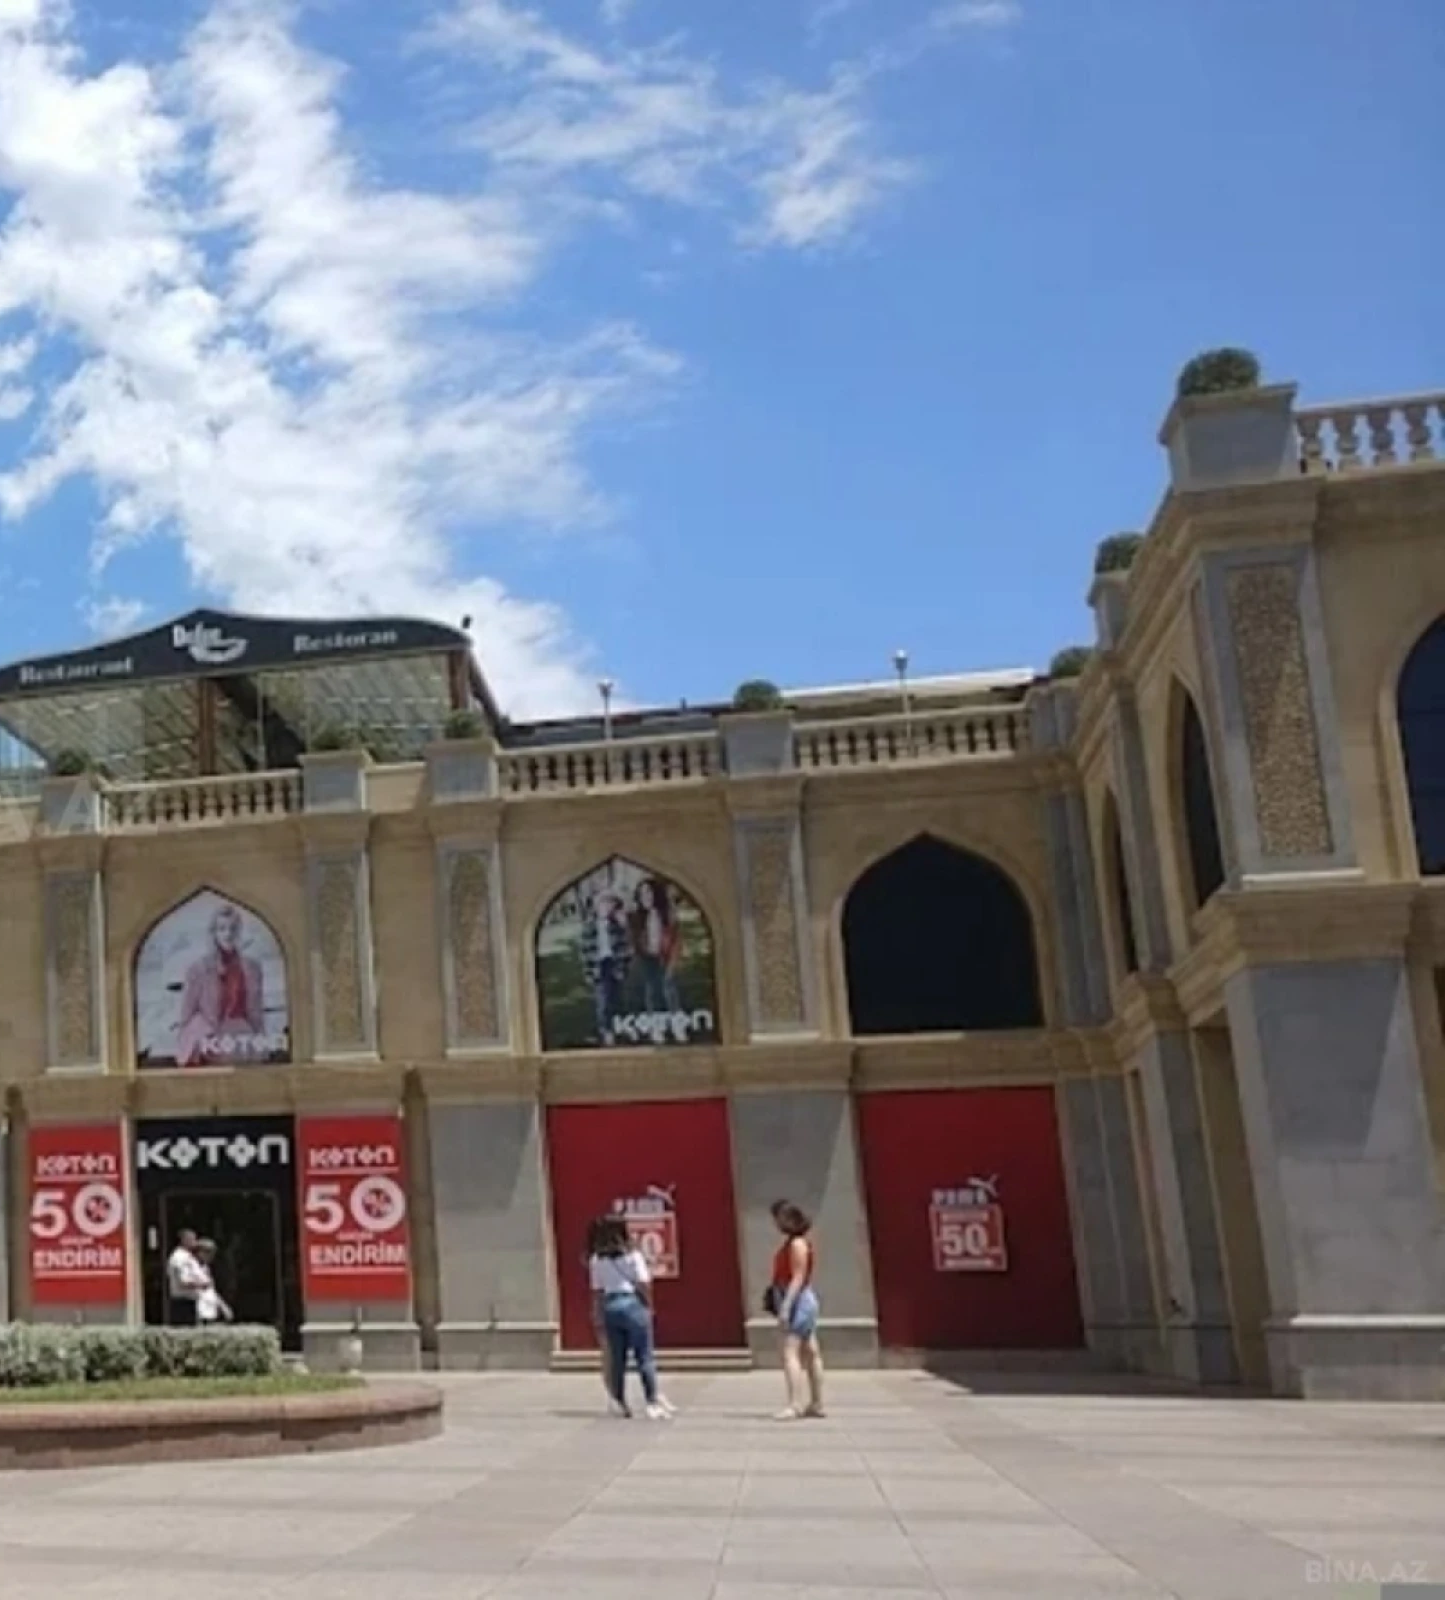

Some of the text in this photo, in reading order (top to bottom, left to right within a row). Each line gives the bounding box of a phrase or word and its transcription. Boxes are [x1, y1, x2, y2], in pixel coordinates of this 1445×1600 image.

[37, 1153, 116, 1175] KOTON
[137, 1134, 289, 1169] KOTON
[309, 1145, 395, 1168] KOTON
[942, 1223, 988, 1255] 50
